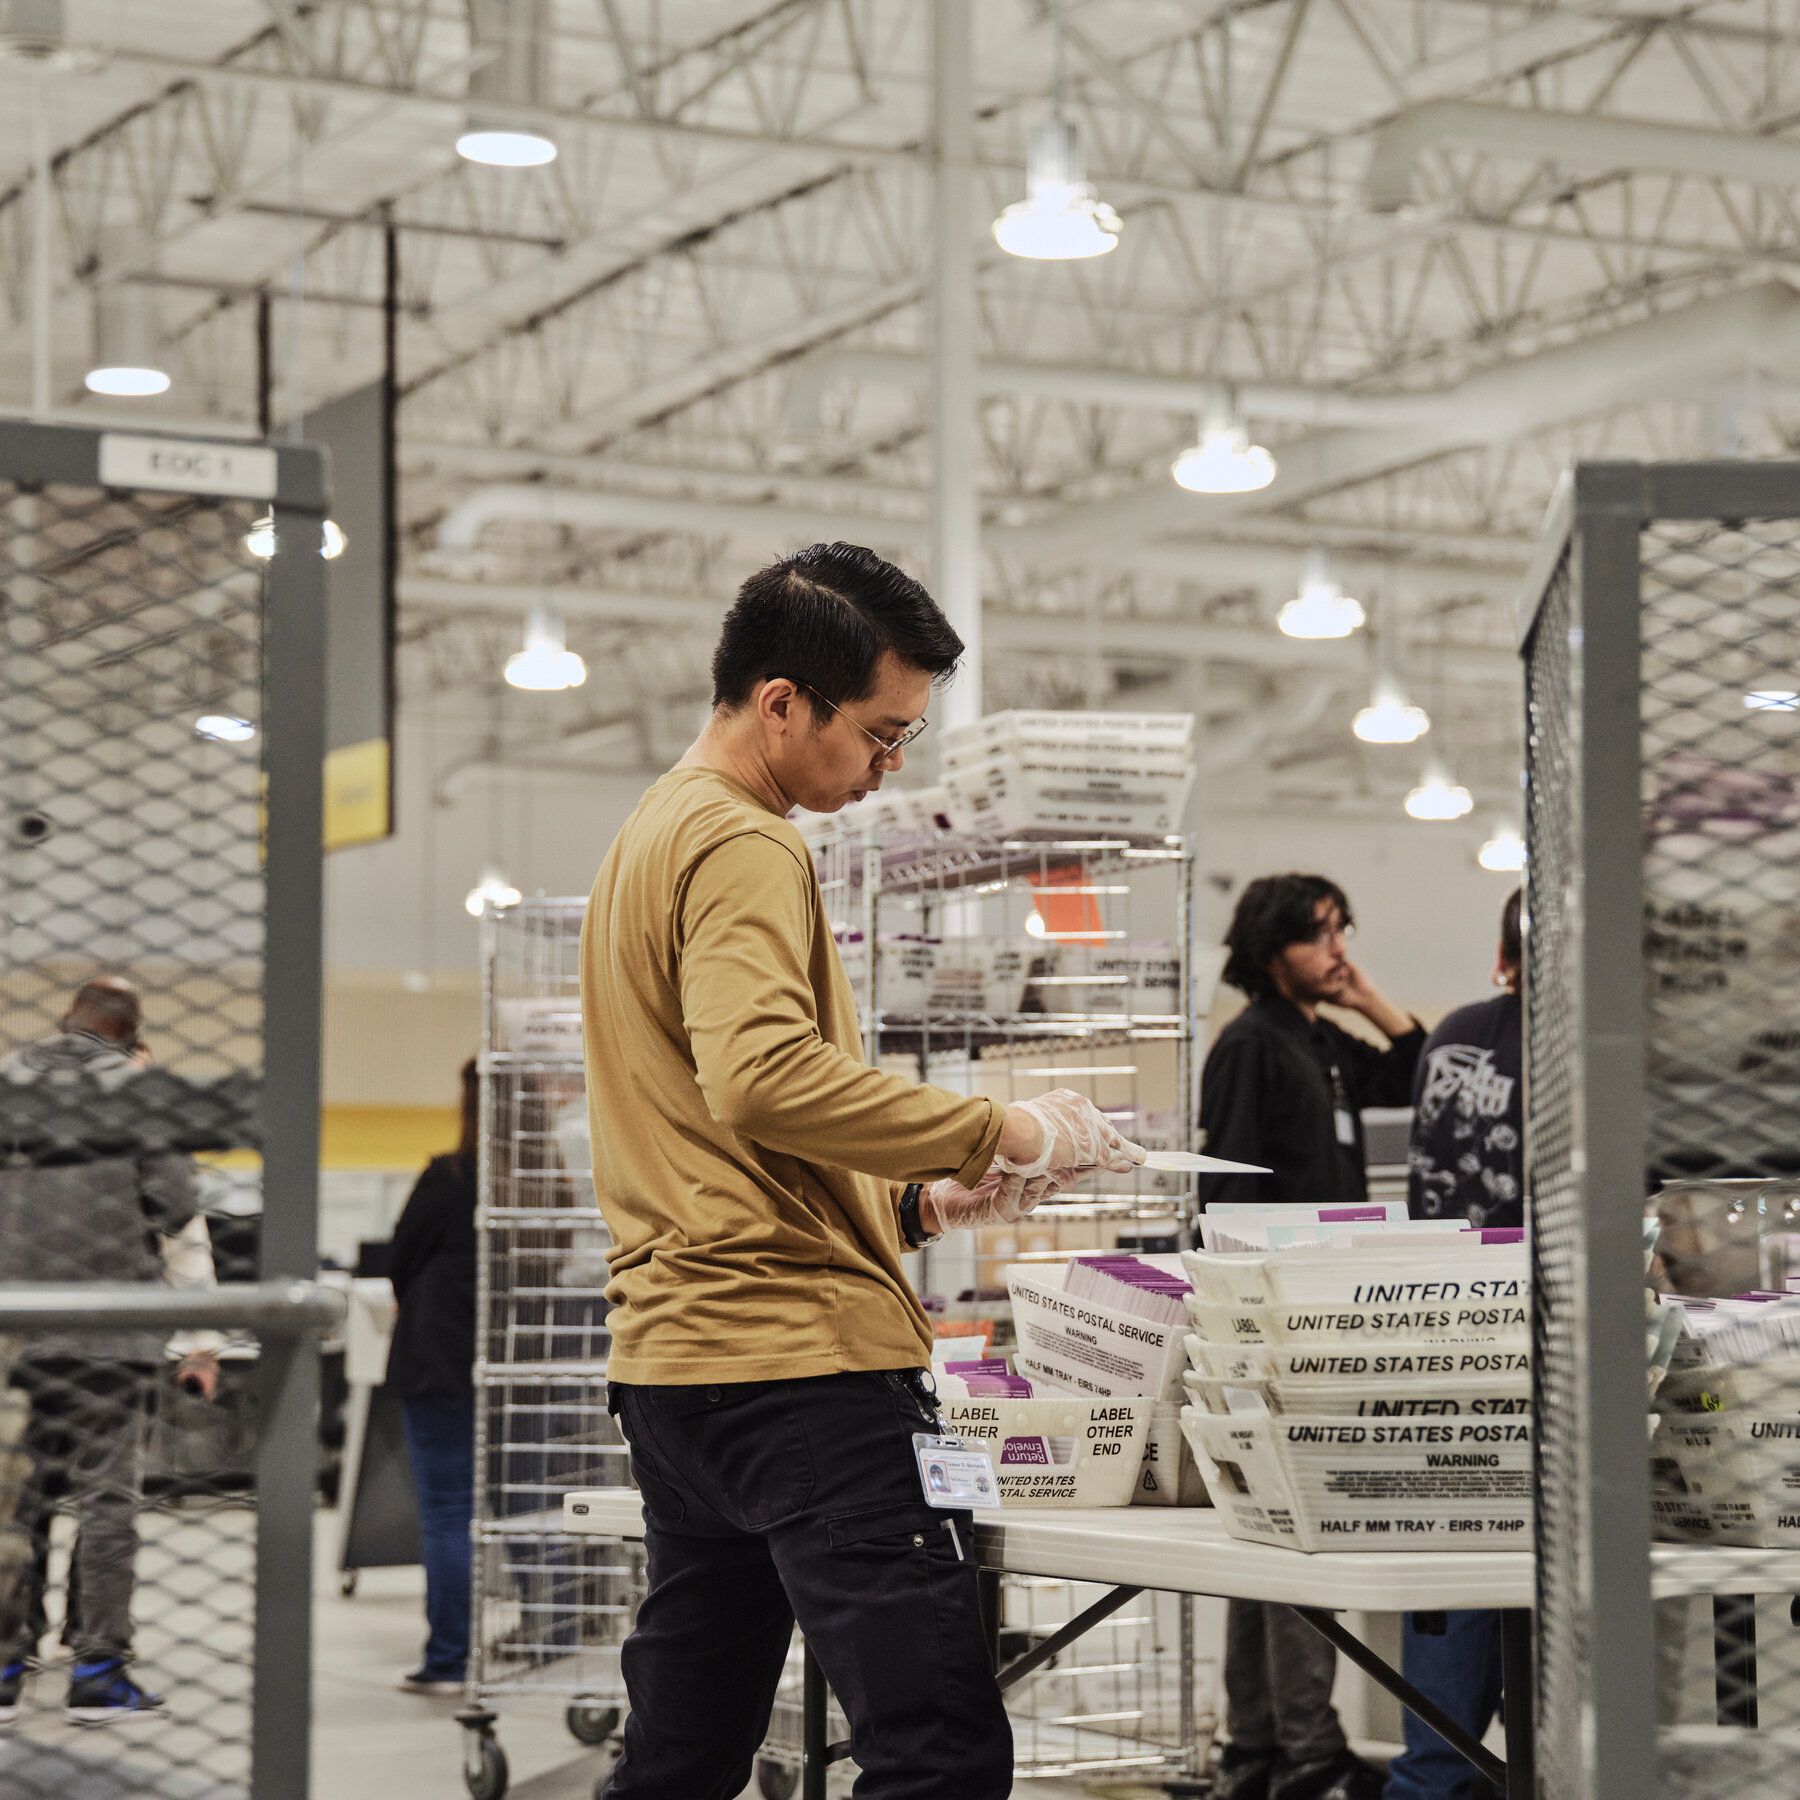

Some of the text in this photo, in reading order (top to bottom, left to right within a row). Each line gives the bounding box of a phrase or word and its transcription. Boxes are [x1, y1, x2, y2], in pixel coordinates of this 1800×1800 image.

[1354, 1281, 1518, 1302] UNITED STA
[1012, 1283, 1164, 1348] UNITED STATES POSTAL SERVICE
[1287, 1308, 1525, 1331] UNITED STATES POSTA
[1231, 1318, 1261, 1333] LABEL
[1065, 1326, 1098, 1346] WARNING
[1290, 1354, 1529, 1373] UNITED STATES POSTA
[1025, 1357, 1041, 1371] HALF
[1042, 1363, 1054, 1376] MM
[1055, 1368, 1073, 1382] TRAY
[1077, 1378, 1094, 1392] EIRS
[951, 1407, 999, 1420] LABEL
[1090, 1407, 1134, 1421] LABEL
[1358, 1399, 1529, 1416] UNITED STAT
[1087, 1425, 1133, 1438] OTHER
[1288, 1425, 1529, 1442] UNITED STATES POSTA
[1751, 1422, 1800, 1438] UNIT
[1092, 1443, 1121, 1456] END
[1008, 1452, 1045, 1463] Return
[1426, 1454, 1500, 1467] WARNING
[1033, 1476, 1076, 1486] STATES
[1000, 1488, 1077, 1499] STAL SERVICE
[1320, 1520, 1360, 1533] HALF
[1365, 1520, 1390, 1533] MM
[1396, 1520, 1435, 1533] TRAY
[1449, 1520, 1482, 1533] EIRS
[1485, 1520, 1525, 1533] 74HP
[1778, 1516, 1800, 1527] HAL
